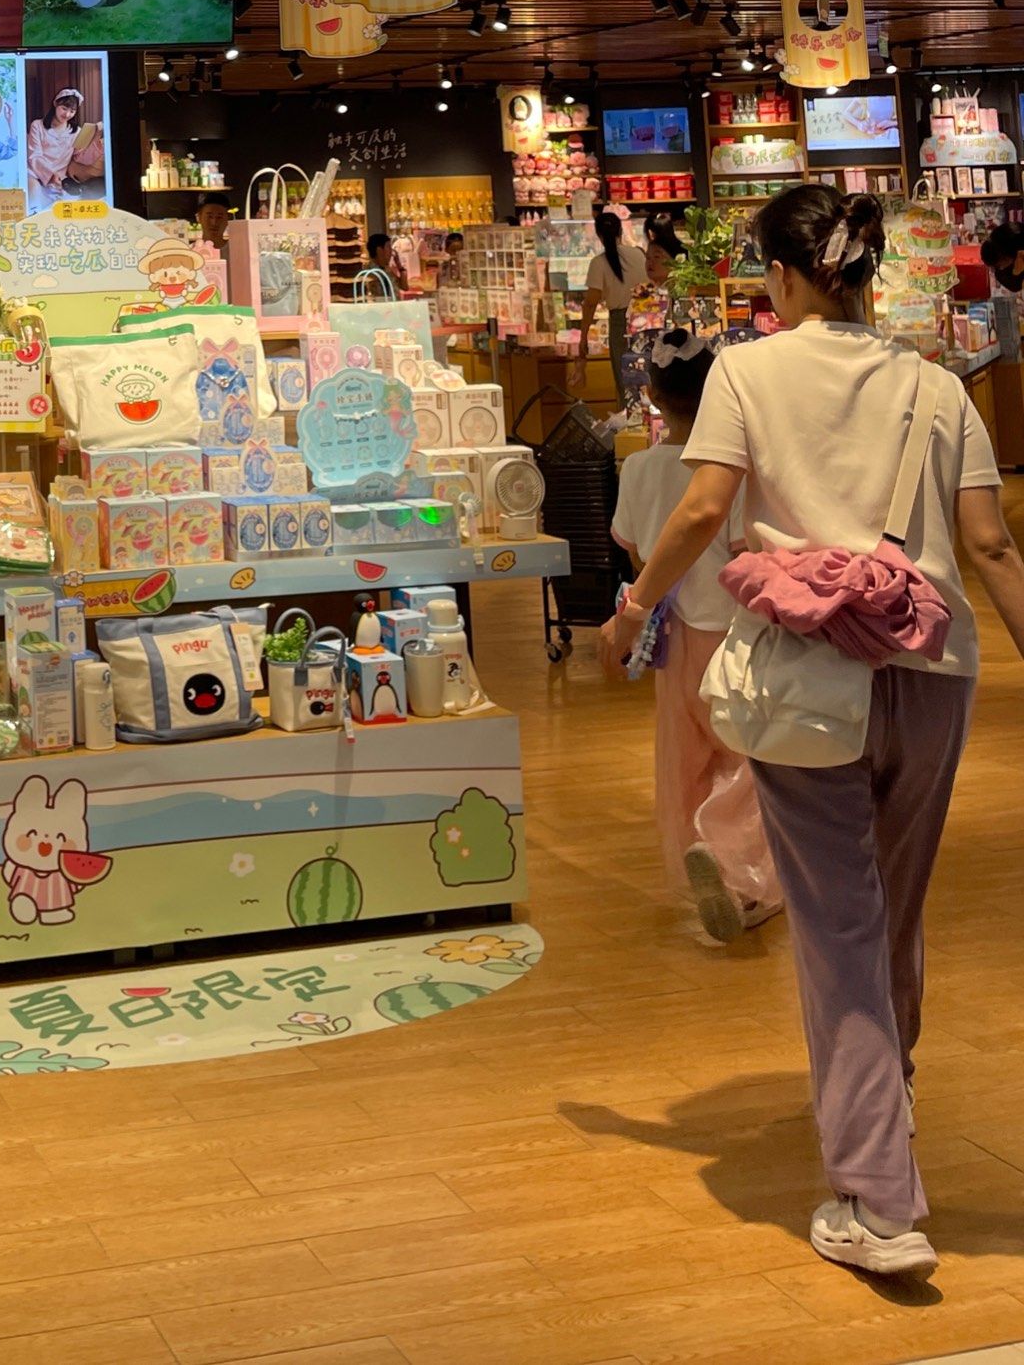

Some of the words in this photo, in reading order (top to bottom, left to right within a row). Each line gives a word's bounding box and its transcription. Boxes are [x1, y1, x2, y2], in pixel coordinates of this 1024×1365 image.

[348, 142, 407, 162] 文创生活
[0, 221, 129, 252] 夏天来杂物社
[16, 248, 139, 274] 实现吃瓜自由
[100, 364, 129, 387] HAPPY
[134, 363, 169, 384] MELON
[74, 589, 130, 609] Sweet
[9, 964, 352, 1047] 夏日限定
